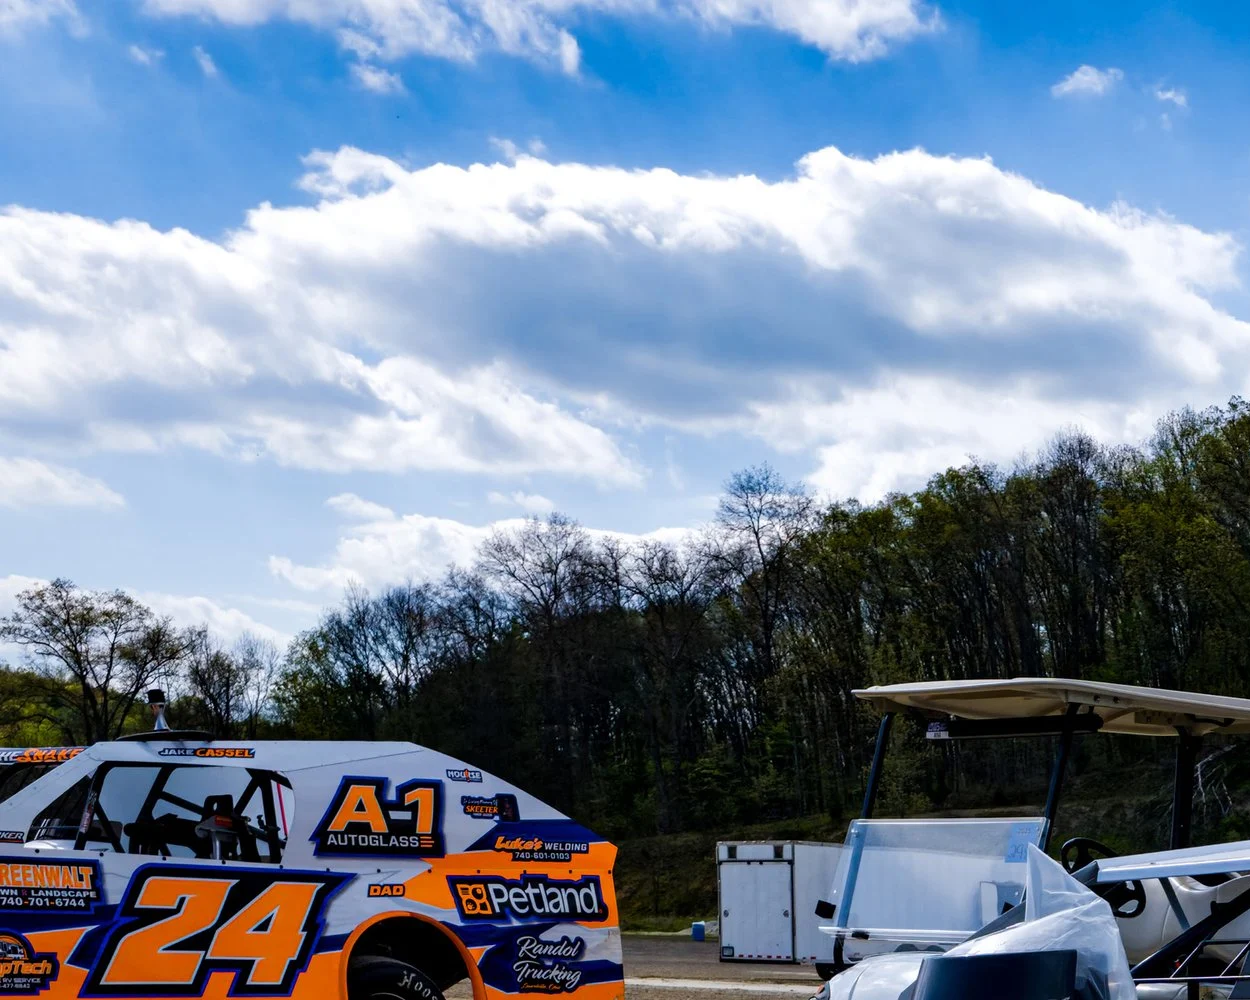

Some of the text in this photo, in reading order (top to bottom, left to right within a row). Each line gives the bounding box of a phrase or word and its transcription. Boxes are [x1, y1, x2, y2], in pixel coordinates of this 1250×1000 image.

[196, 749, 253, 758] CASSEL
[327, 785, 434, 834] A-1
[465, 804, 499, 814] SKEETER
[327, 834, 419, 847] AUTOGLASS
[495, 836, 587, 851] Luke's WELDING
[515, 851, 570, 860] 740-601-0103
[31, 889, 97, 898] LANDSCAPE
[369, 885, 404, 896] DAD
[488, 882, 599, 914] Petland
[101, 877, 325, 985] 24
[516, 935, 581, 957] Randol
[513, 960, 582, 988] Trucking
